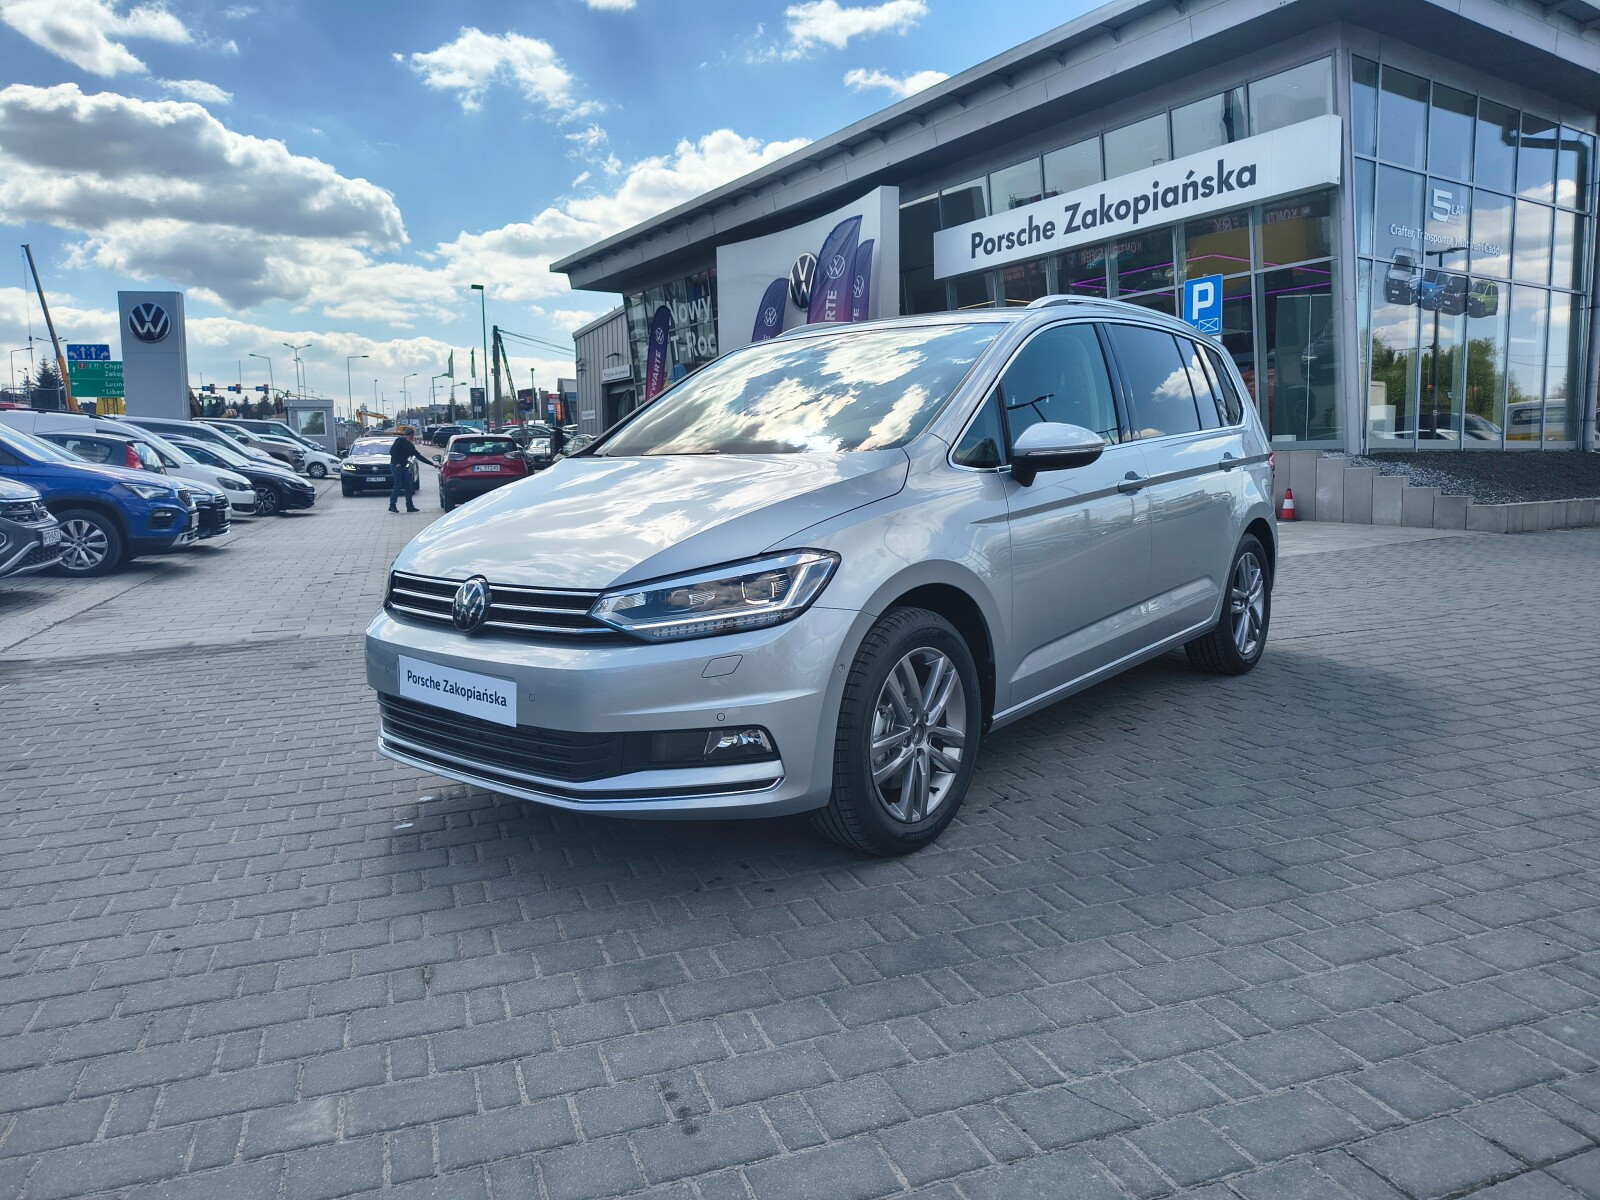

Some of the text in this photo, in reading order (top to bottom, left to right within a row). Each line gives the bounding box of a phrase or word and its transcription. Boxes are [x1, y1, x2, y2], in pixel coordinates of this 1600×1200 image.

[970, 158, 1258, 260] Porsche Zakopiańska
[1431, 188, 1453, 223] 5
[1451, 203, 1465, 216] LAT
[665, 295, 712, 325] Nowy
[1192, 281, 1215, 320] P
[105, 370, 124, 378] Zakop
[649, 349, 662, 399] TWARTE
[407, 669, 508, 707] Porsche Zakopiańska
